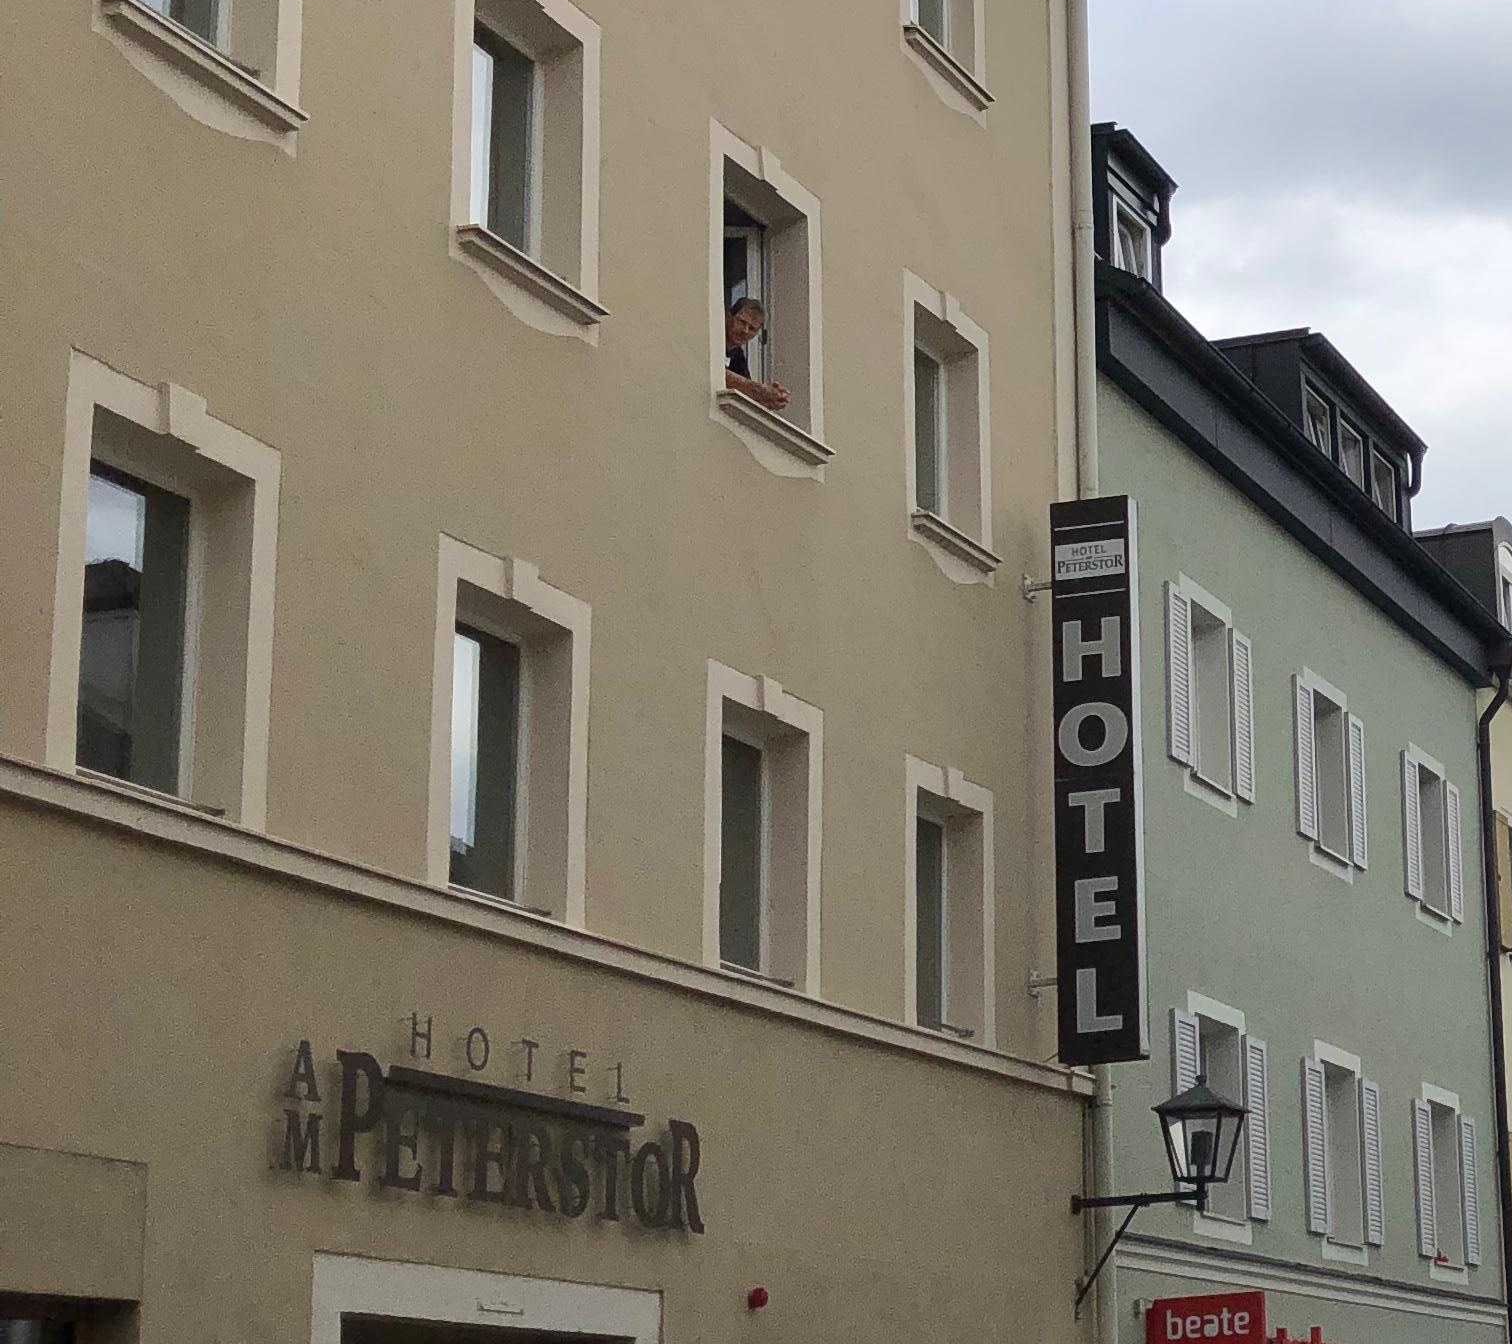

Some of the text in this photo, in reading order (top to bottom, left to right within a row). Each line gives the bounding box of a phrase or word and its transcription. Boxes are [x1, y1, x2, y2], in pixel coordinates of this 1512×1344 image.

[1057, 554, 1124, 574] PETERSTOR
[1072, 545, 1106, 556] HOTEL
[1058, 616, 1128, 1034] HOTEL
[409, 1011, 630, 1104] HOTEL
[330, 1049, 705, 1235] PETERSTOR
[1166, 1307, 1250, 1341] beate
